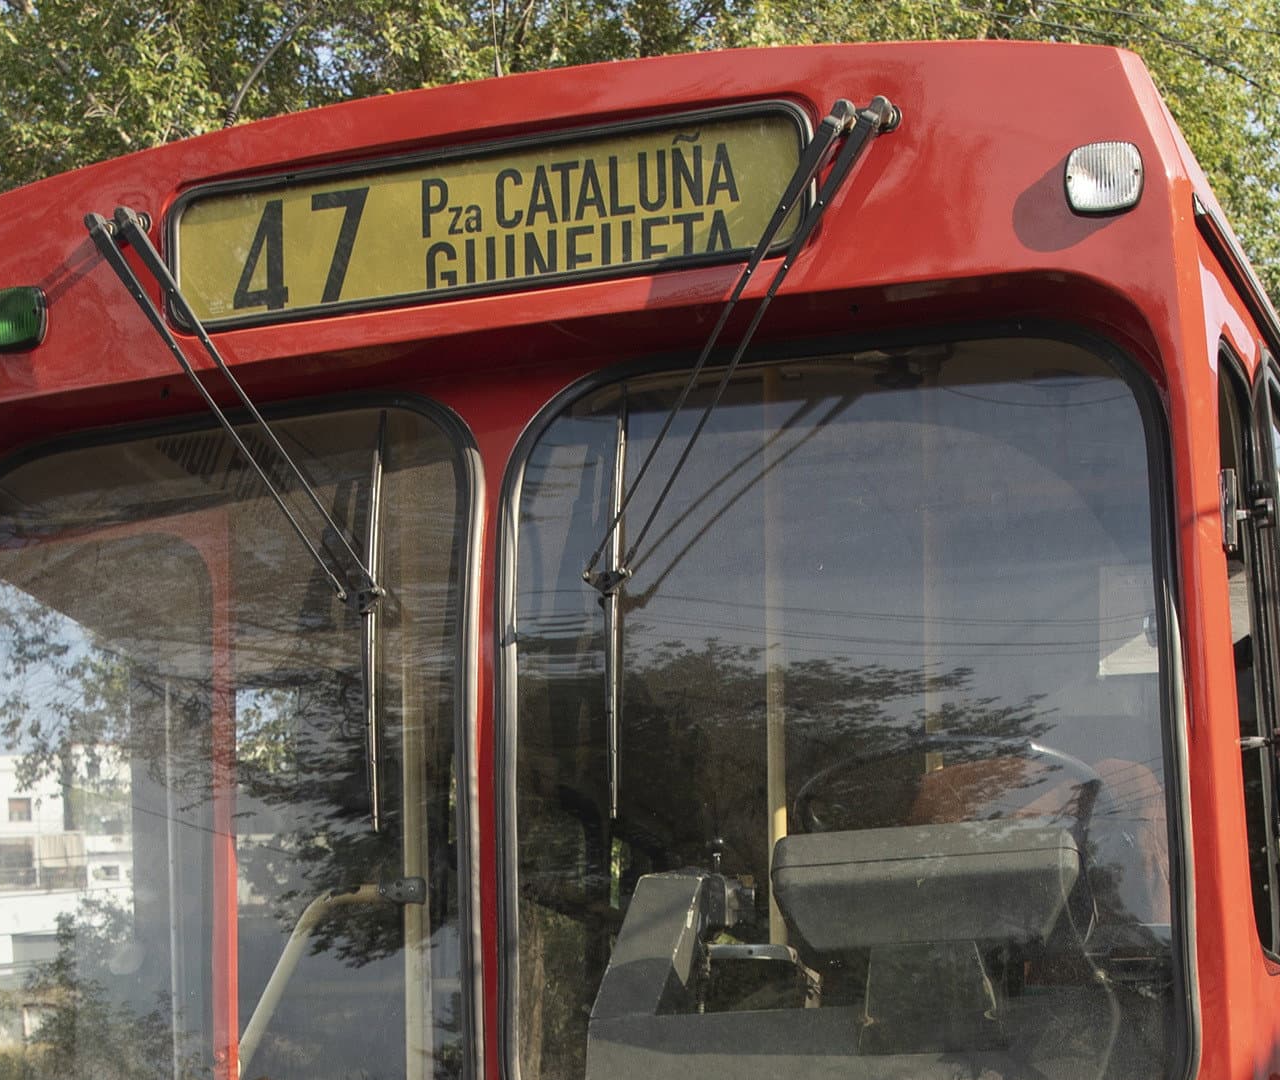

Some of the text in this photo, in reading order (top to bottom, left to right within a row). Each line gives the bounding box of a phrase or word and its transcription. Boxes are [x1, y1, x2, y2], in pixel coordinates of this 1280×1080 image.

[421, 131, 740, 238] Pza CATALUÑA
[233, 186, 370, 312] 47
